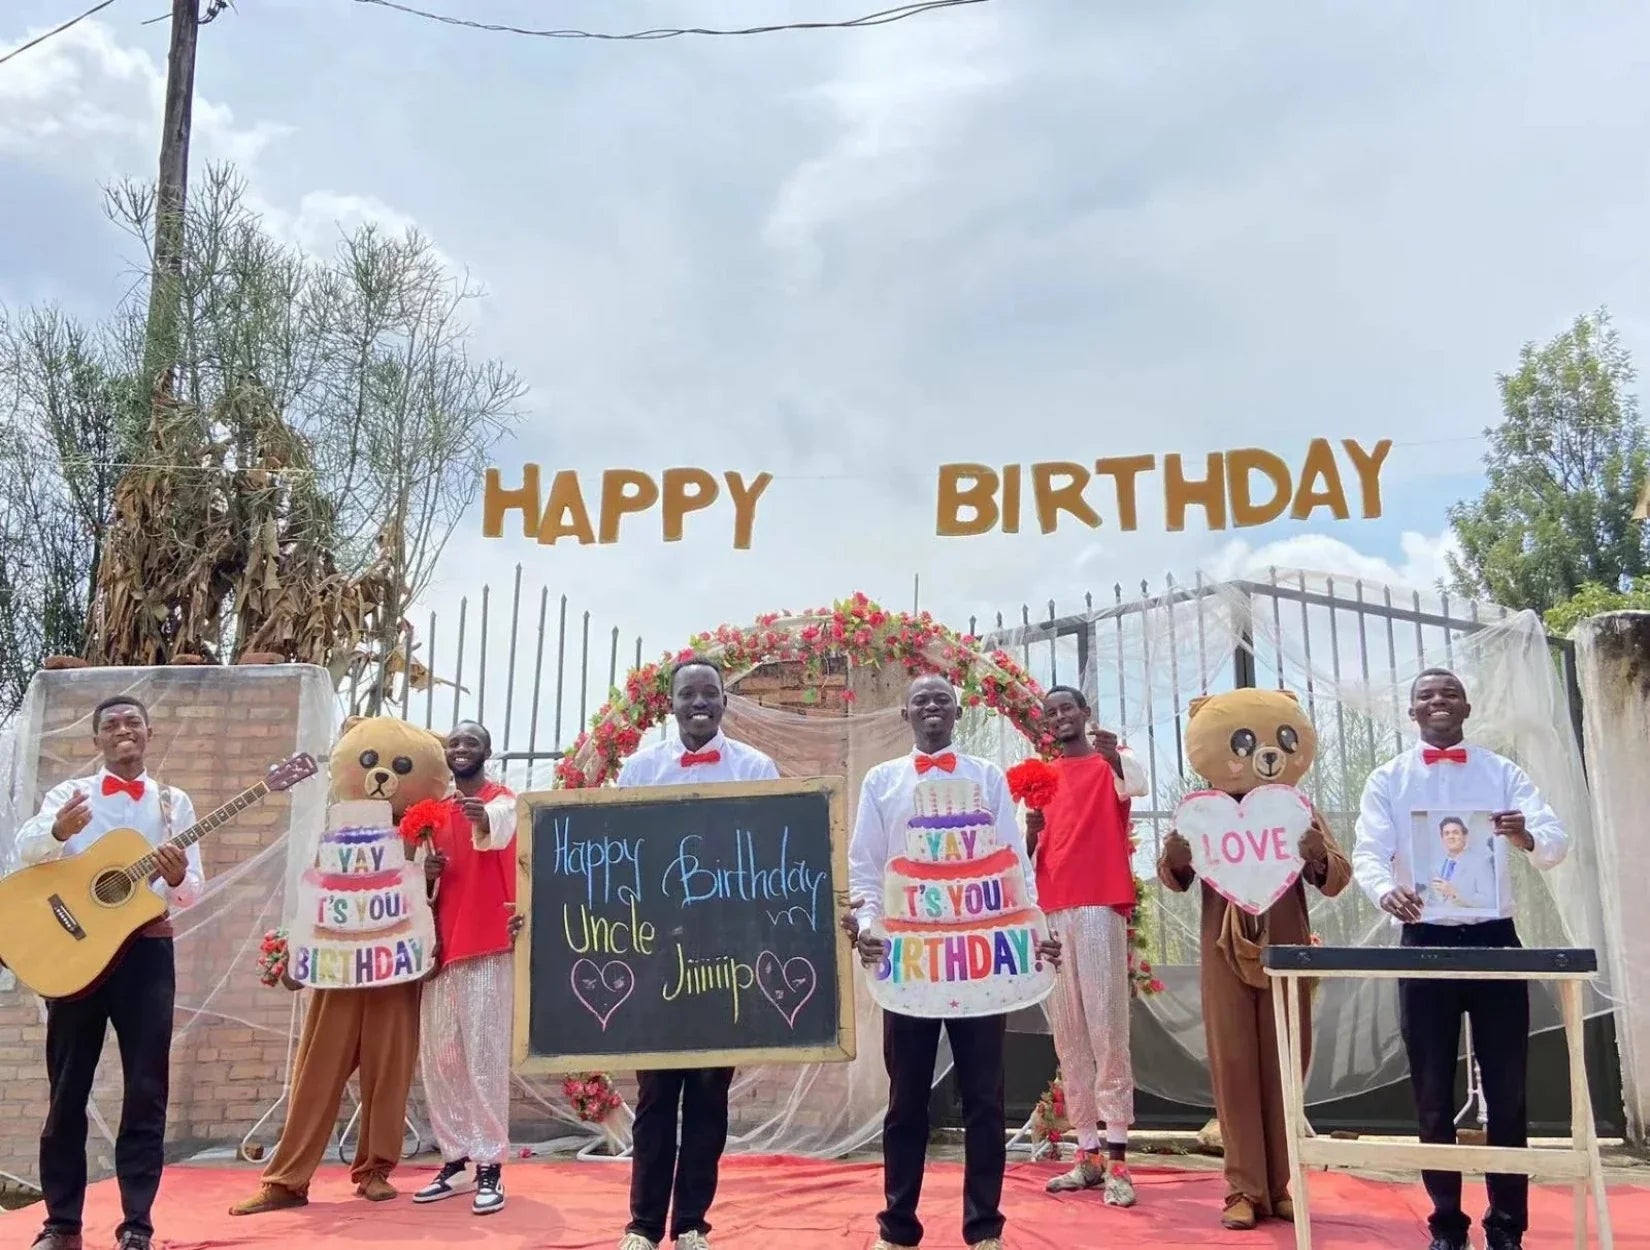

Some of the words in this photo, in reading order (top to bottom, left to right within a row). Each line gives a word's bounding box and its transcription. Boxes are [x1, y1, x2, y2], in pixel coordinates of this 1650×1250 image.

[482, 463, 773, 549] HAPPY
[936, 438, 1393, 537] BIRTHDAY
[338, 847, 384, 873] YAY
[927, 830, 976, 861] YAY
[1202, 827, 1290, 865] LOVE
[554, 816, 644, 910] Happy
[662, 826, 827, 932] Birthday
[564, 894, 655, 954] Uncle
[294, 938, 423, 983] BIRTHDAY
